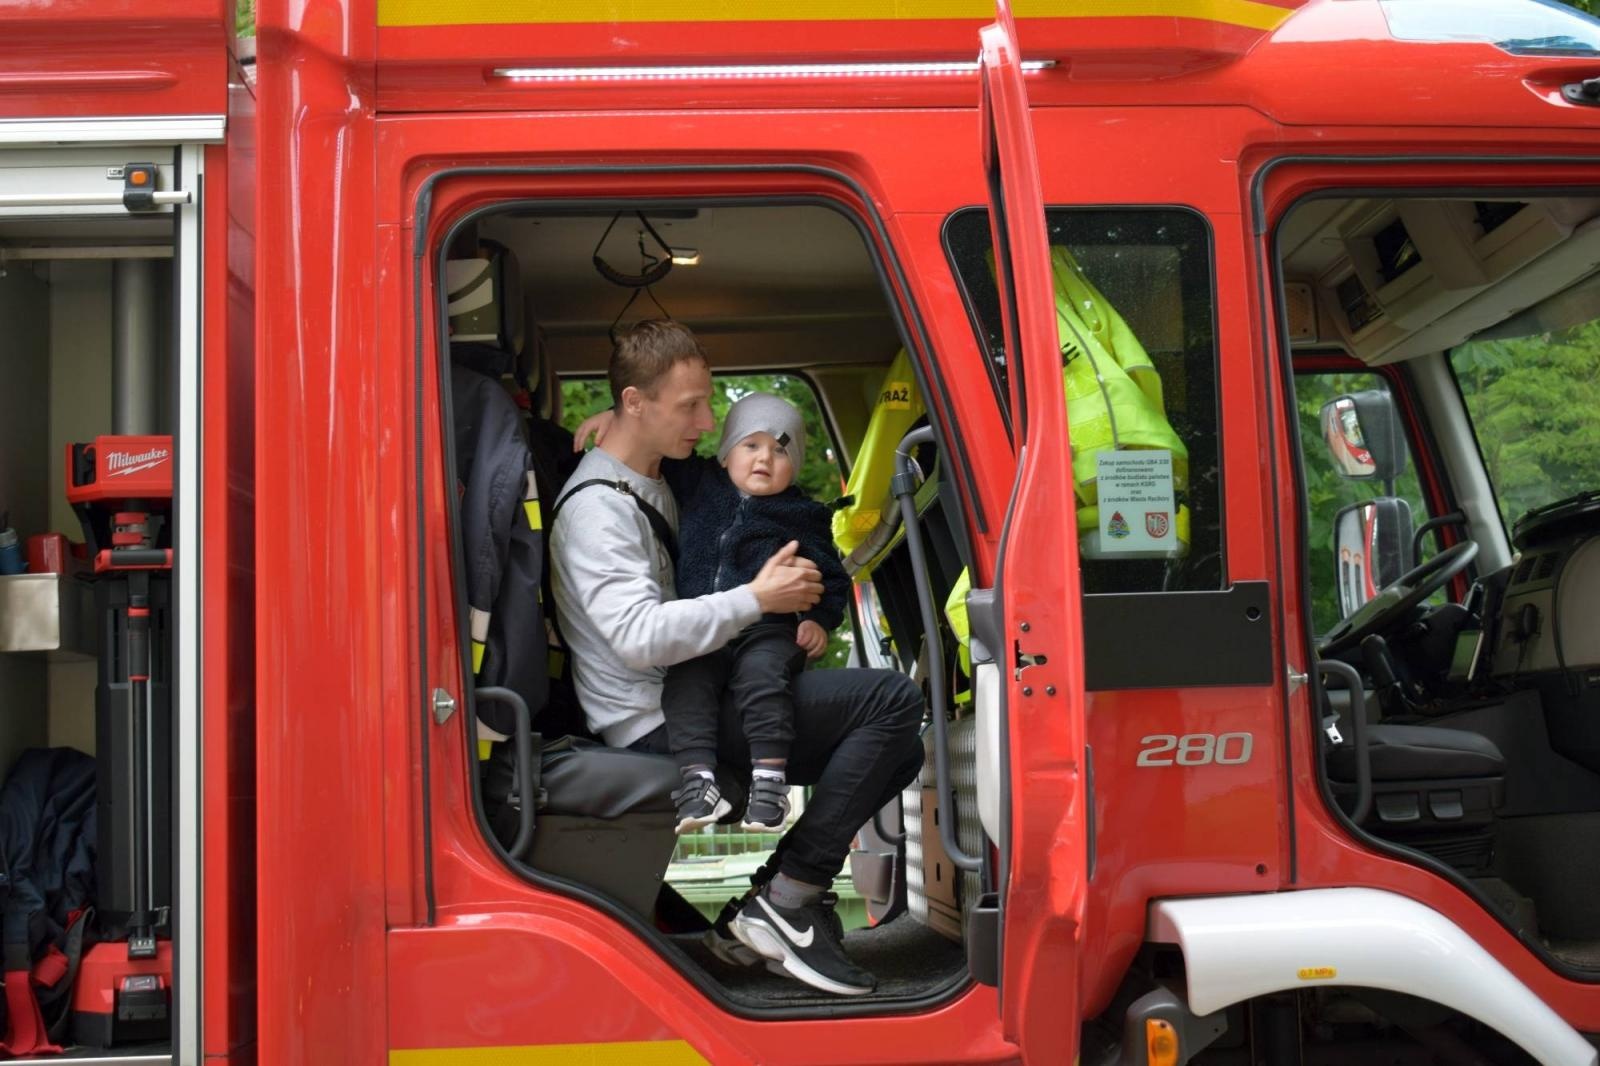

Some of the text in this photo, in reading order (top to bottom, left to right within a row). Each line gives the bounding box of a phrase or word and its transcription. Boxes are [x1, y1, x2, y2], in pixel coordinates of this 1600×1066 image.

[880, 387, 909, 402] TRAŻ
[106, 448, 168, 471] Milwaukee
[1136, 732, 1253, 767] 280
